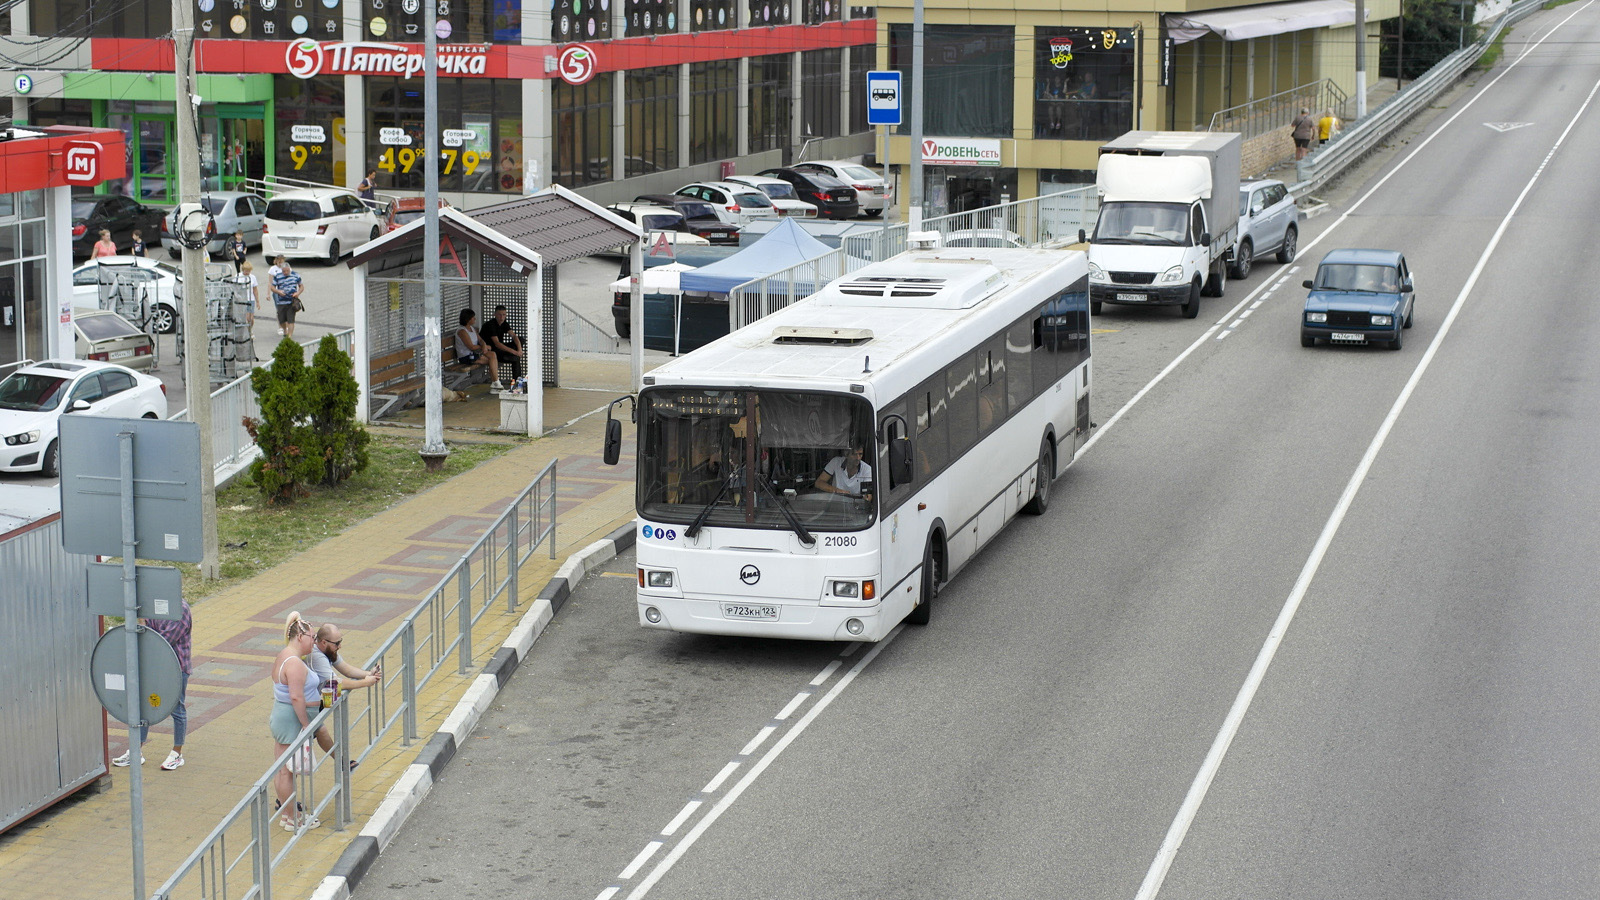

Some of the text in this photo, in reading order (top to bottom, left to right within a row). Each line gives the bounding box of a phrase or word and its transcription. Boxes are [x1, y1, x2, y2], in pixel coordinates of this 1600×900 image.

[437, 45, 486, 53] ИВЕРСАМ
[323, 41, 487, 80] Пятёрчка
[294, 126, 320, 134] Горячая
[383, 129, 400, 137] Кофе
[291, 145, 322, 170] 9 99
[378, 147, 416, 174] 49
[825, 536, 857, 547] 21080
[726, 606, 775, 616] Р723КН 123
